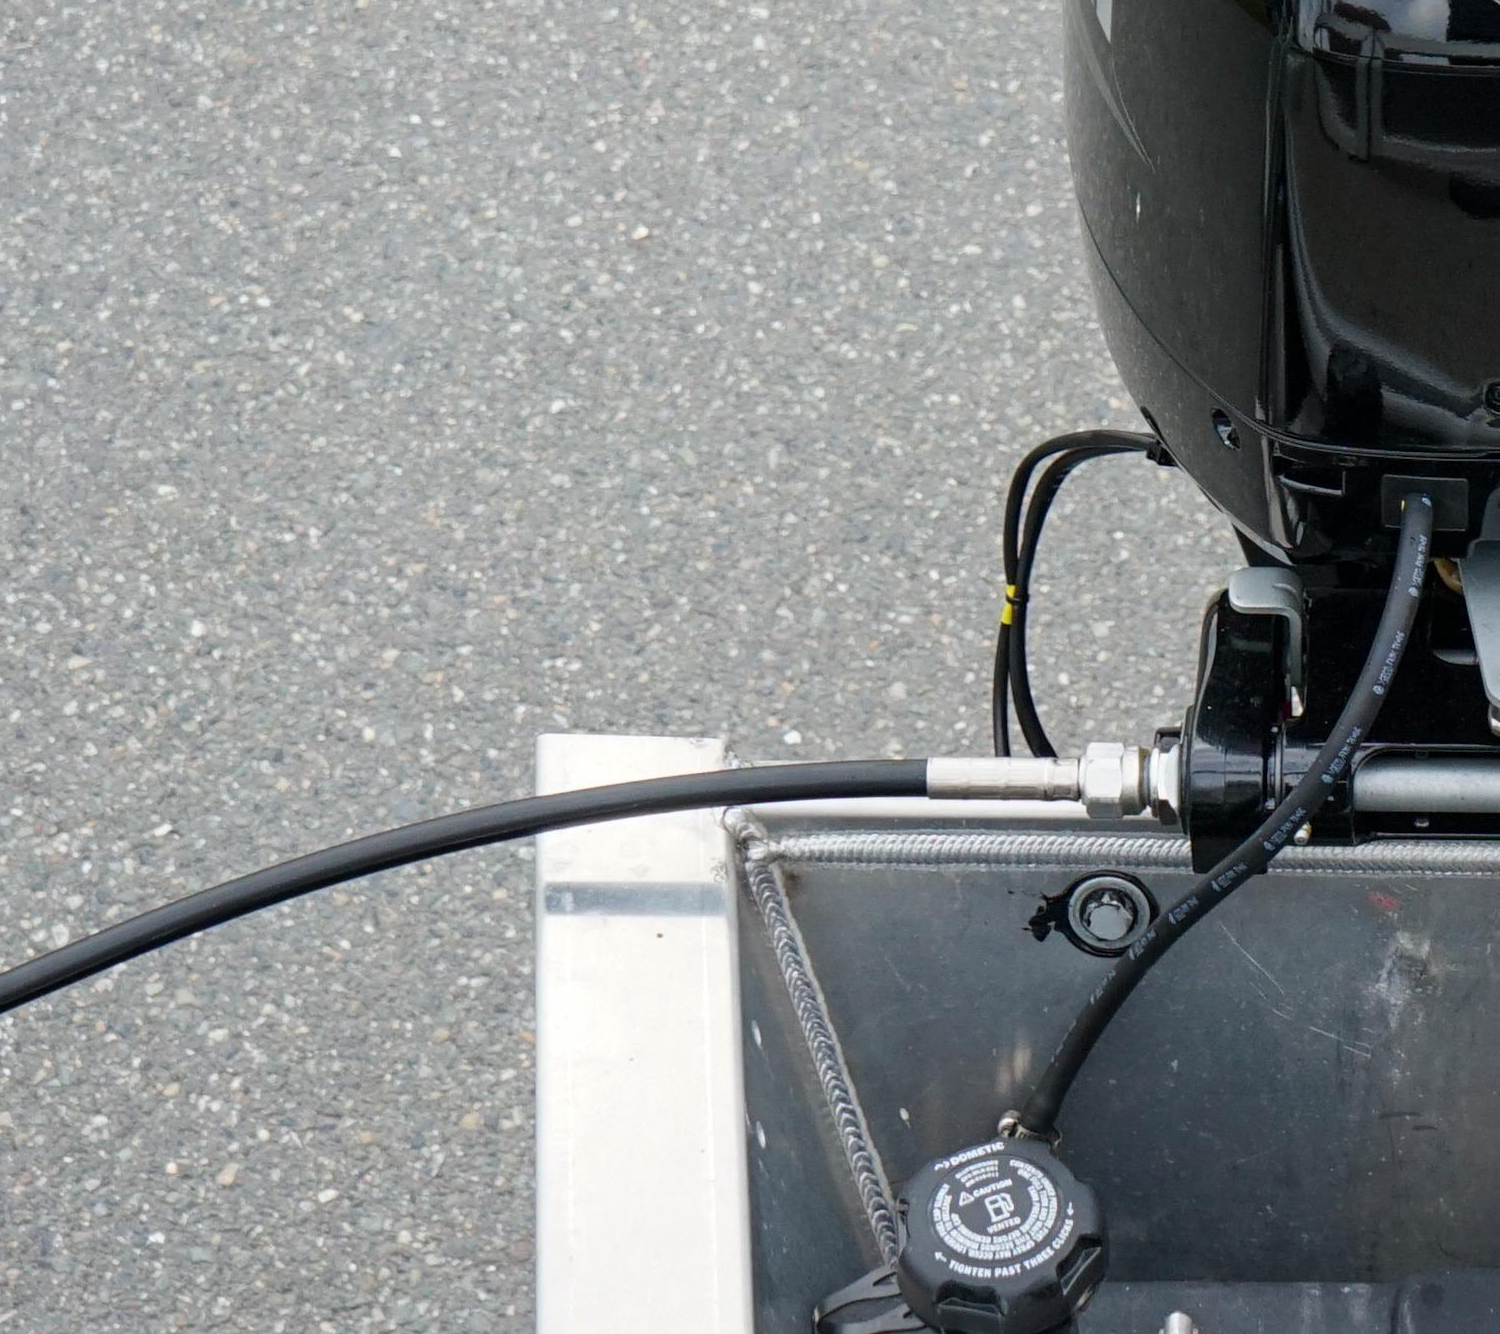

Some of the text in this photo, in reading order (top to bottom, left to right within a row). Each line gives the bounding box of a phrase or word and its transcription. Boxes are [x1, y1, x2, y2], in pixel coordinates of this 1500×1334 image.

[950, 1142, 1005, 1166] DOMETIC
[973, 1178, 1013, 1197] CAUTION
[987, 1216, 1022, 1234] VENTED
[948, 1219, 1074, 1278] TIGHTEN PAST THREE CLICKS
